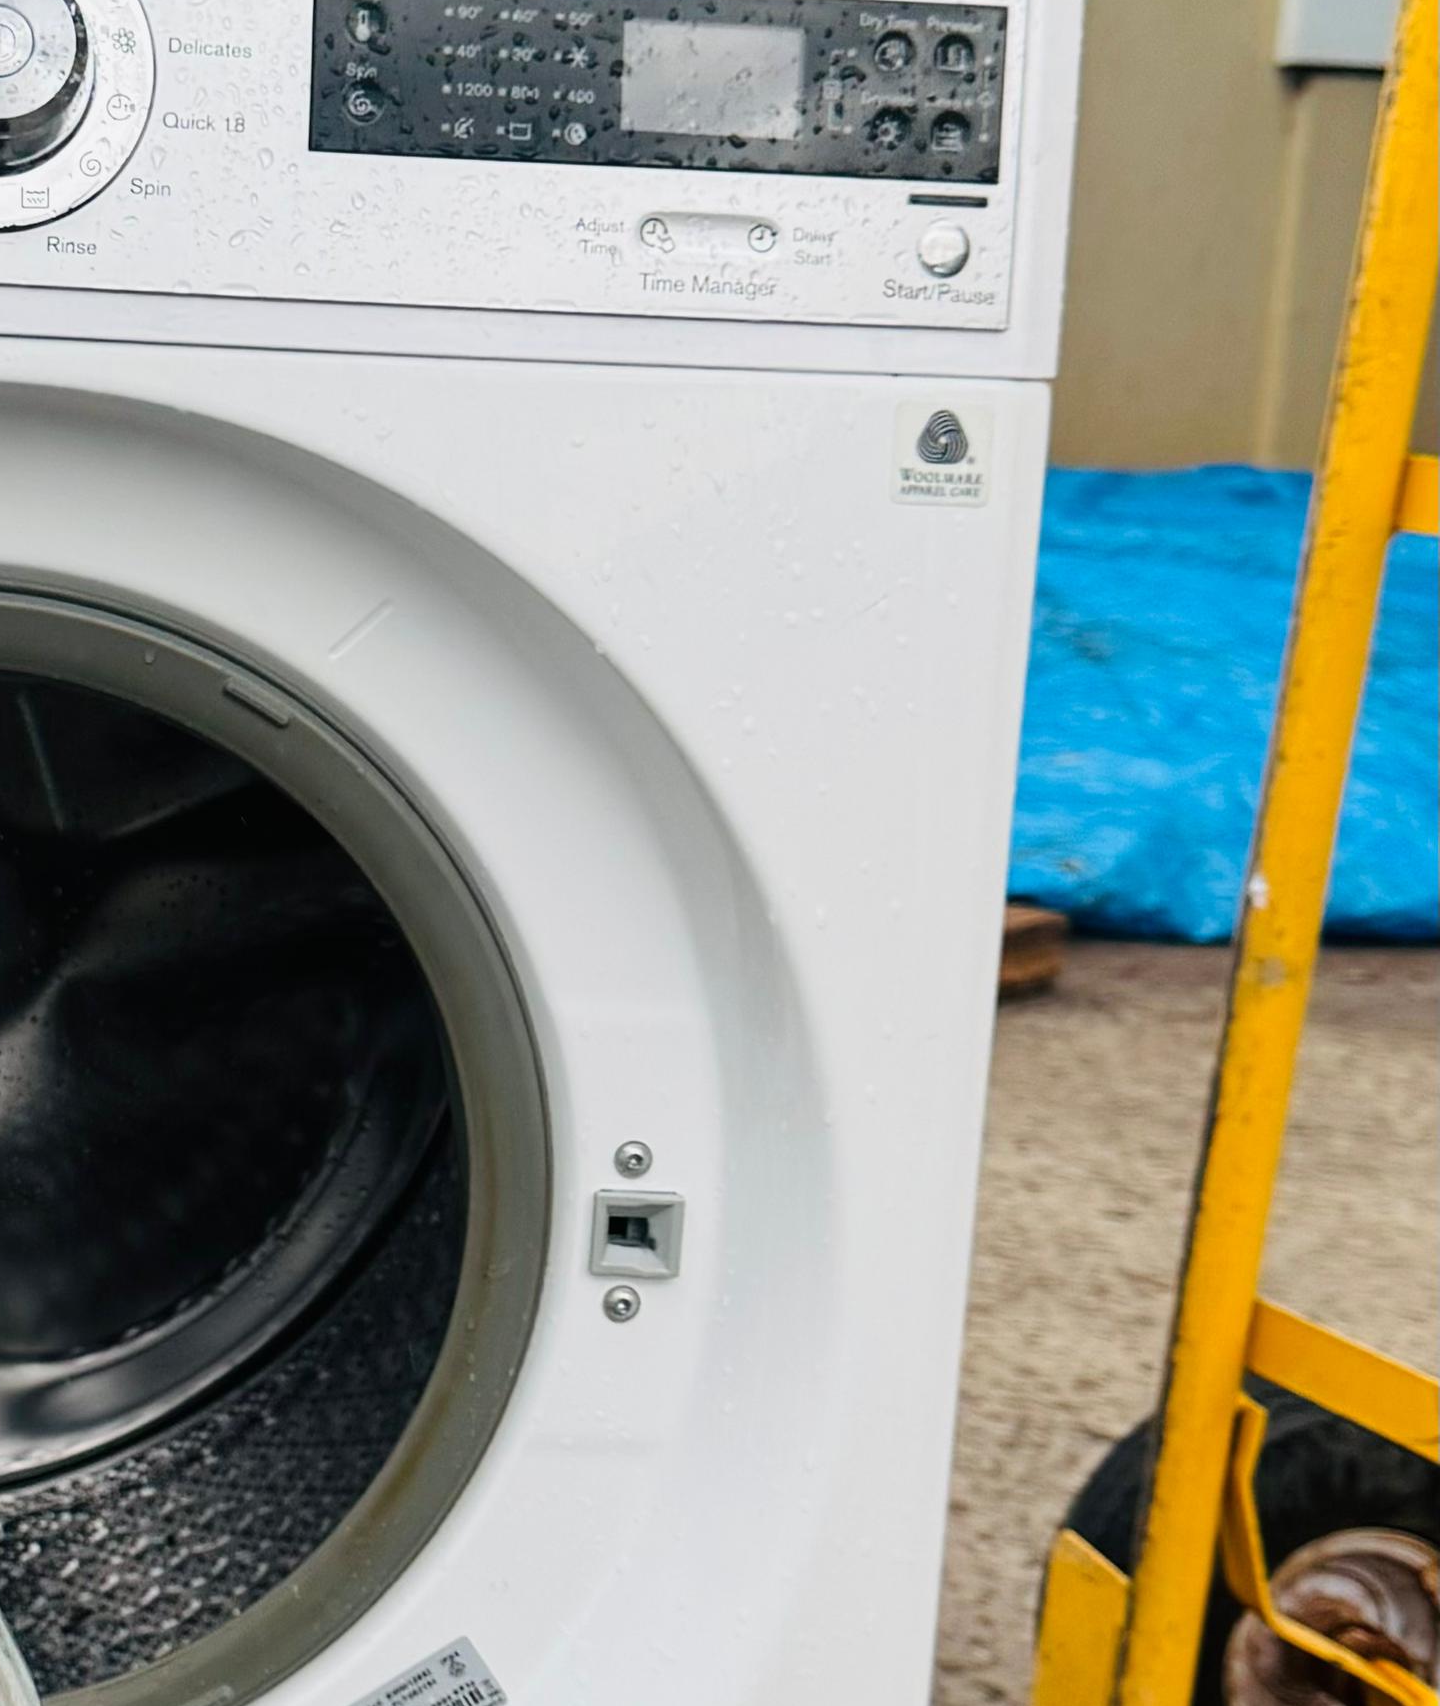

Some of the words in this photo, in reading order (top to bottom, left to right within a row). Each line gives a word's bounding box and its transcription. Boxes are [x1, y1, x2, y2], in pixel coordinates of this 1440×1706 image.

[167, 36, 254, 60] Delicates
[456, 82, 494, 98] 1200
[161, 111, 217, 133] Quick
[129, 177, 172, 200] Spin
[575, 217, 625, 237] Adjust
[46, 236, 98, 256] Rinse
[793, 248, 832, 267] Start
[639, 271, 686, 293] Time
[690, 274, 778, 302] Manager
[881, 278, 996, 306] Start/Pause
